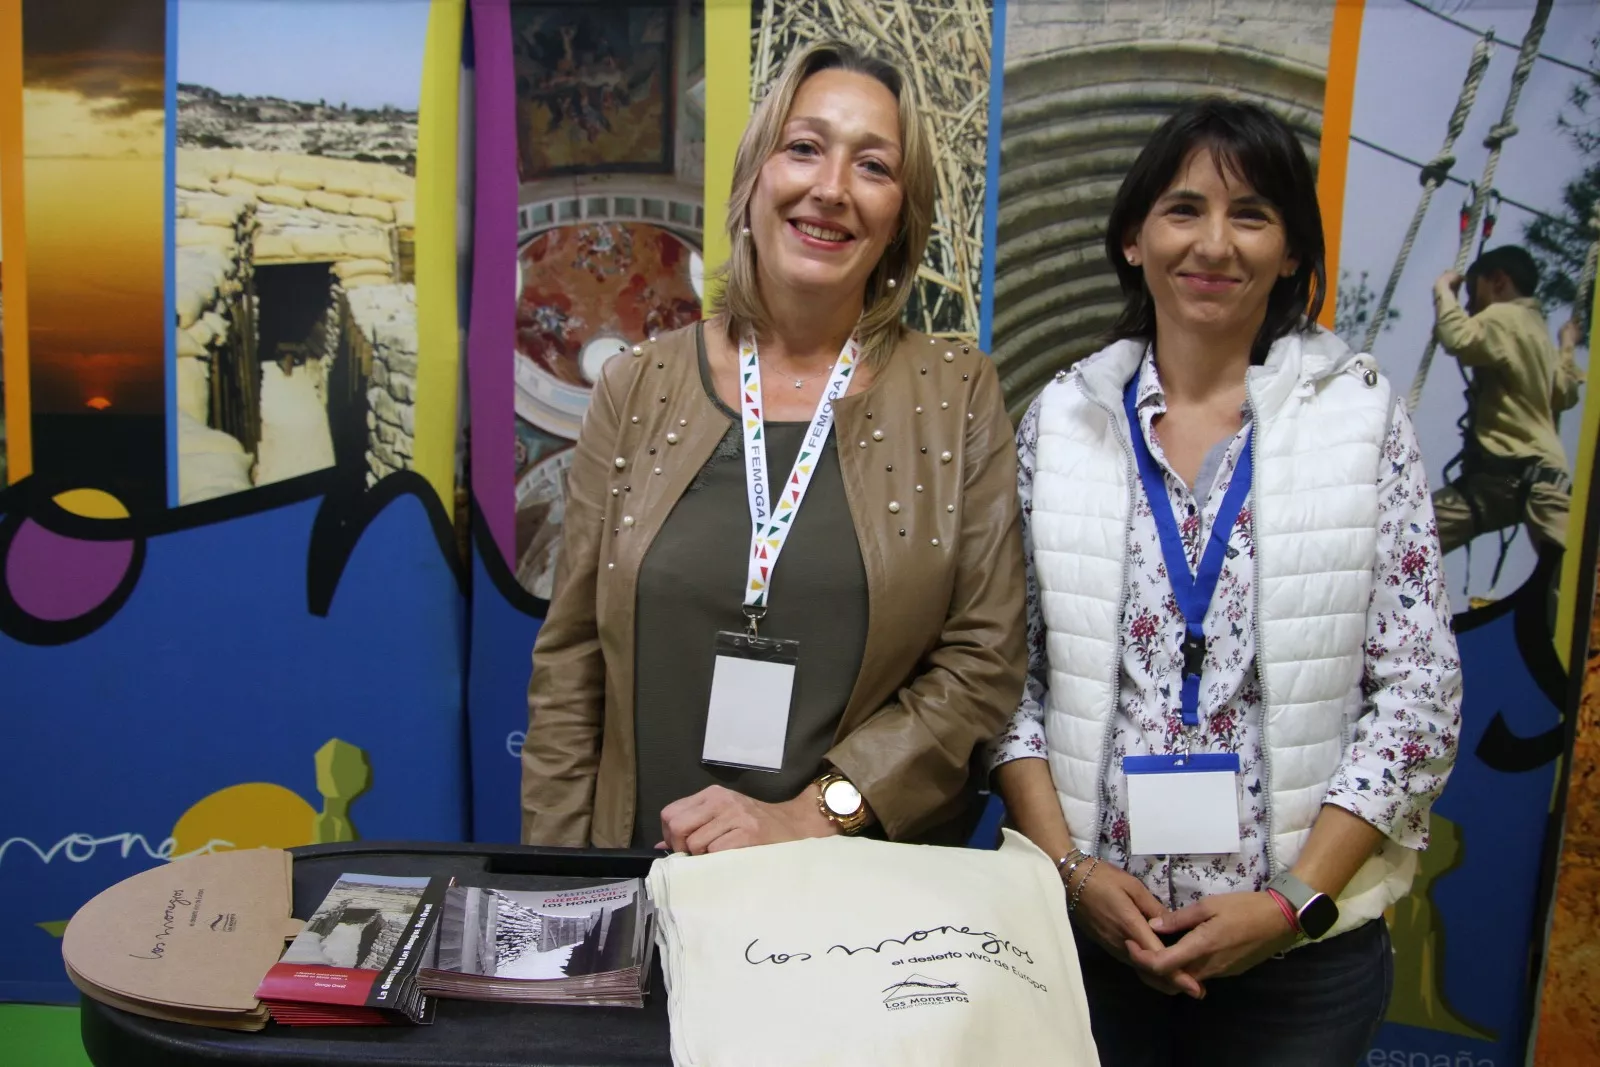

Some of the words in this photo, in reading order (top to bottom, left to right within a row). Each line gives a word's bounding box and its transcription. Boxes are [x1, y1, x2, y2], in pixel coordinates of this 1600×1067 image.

[807, 380, 844, 448] FEMOGA
[751, 445, 767, 518] FEMOGA
[544, 895, 587, 903] GUERRA
[590, 891, 617, 899] CIVIL
[556, 887, 610, 898] VESTIGIOS
[566, 894, 628, 907] MONEGROS
[891, 958, 904, 967] el
[908, 951, 963, 964] desierto
[965, 951, 992, 963] vivo
[994, 959, 1009, 971] de
[1011, 965, 1048, 993] Europa
[377, 991, 389, 1000] La
[885, 1001, 906, 1009] Los
[910, 995, 969, 1004] Monegros
